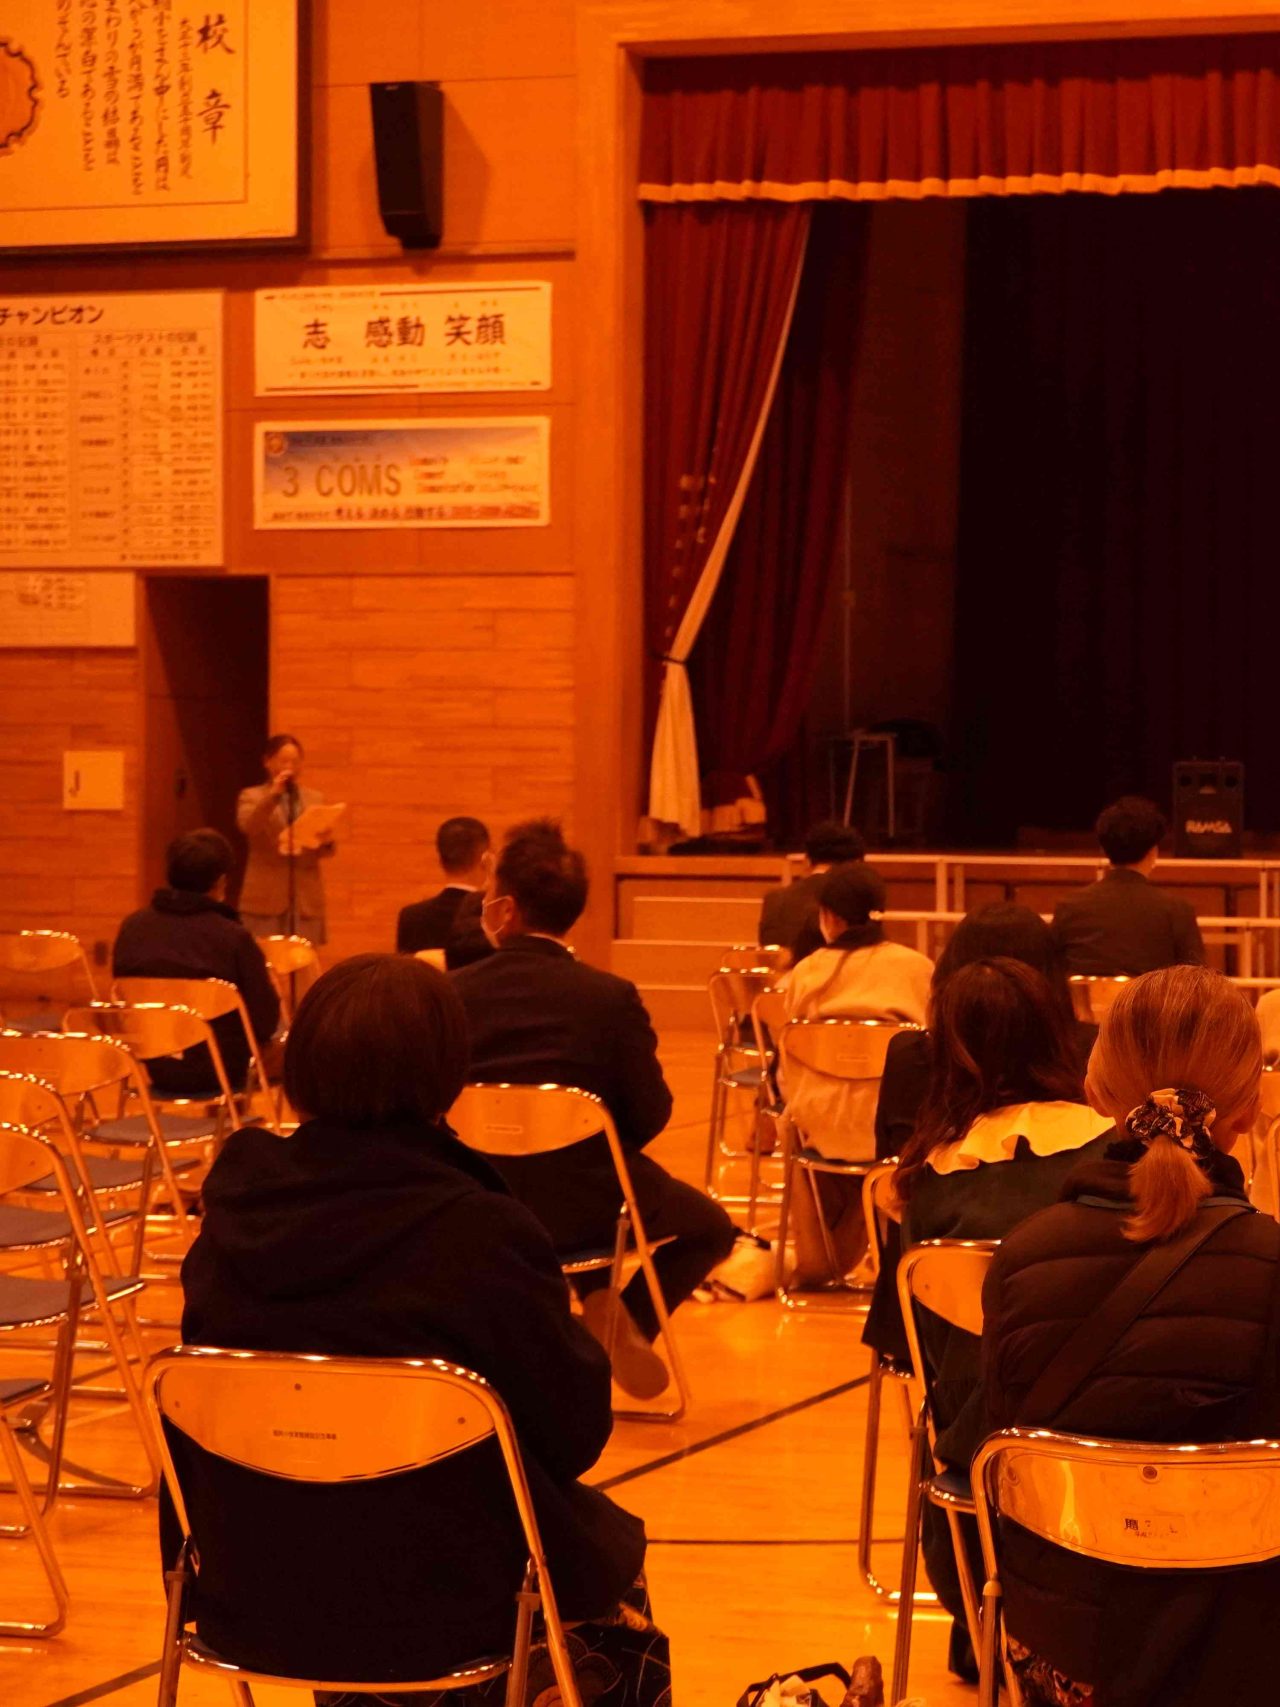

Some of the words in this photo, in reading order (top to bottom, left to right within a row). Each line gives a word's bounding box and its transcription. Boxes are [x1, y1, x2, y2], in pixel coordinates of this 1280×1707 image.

[302, 317, 332, 350] 志
[364, 316, 426, 348] 感動
[444, 313, 507, 347] 笑顔
[281, 465, 301, 498] 3
[314, 462, 402, 498] COMS
